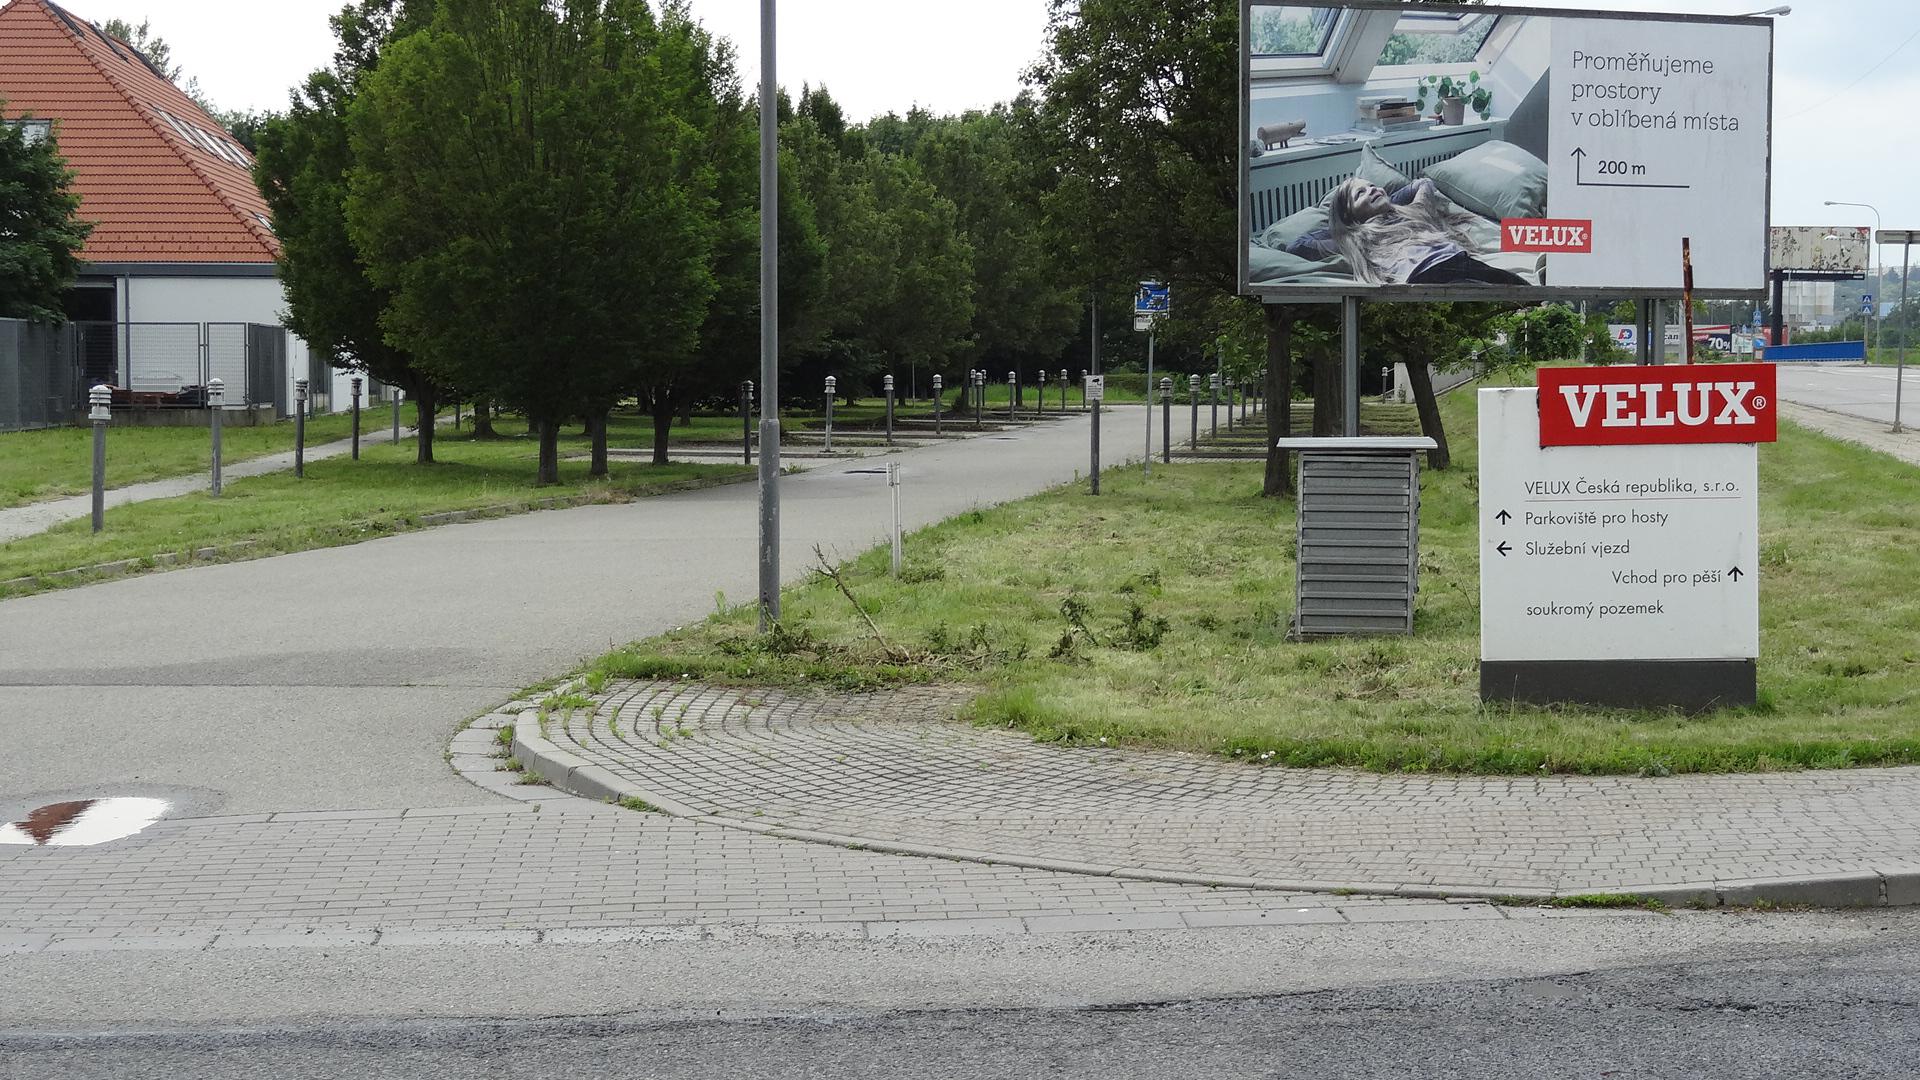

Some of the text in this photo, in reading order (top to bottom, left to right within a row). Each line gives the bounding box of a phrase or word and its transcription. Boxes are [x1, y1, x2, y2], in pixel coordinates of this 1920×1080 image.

[1573, 50, 1714, 77] Proměňujeme
[1571, 82, 1662, 105] prostory
[1571, 109, 1740, 132] v oblíbená místa
[1597, 160, 1647, 175] 200 m
[1524, 476, 1740, 496] VELUX Česká republika, s.r.o.
[1525, 509, 1669, 528] Parkoviště pro hosty
[1525, 539, 1630, 559] Služební vjezd
[1611, 568, 1722, 588] Vchod pro pěší
[1526, 600, 1665, 619] soukromý pozemek
